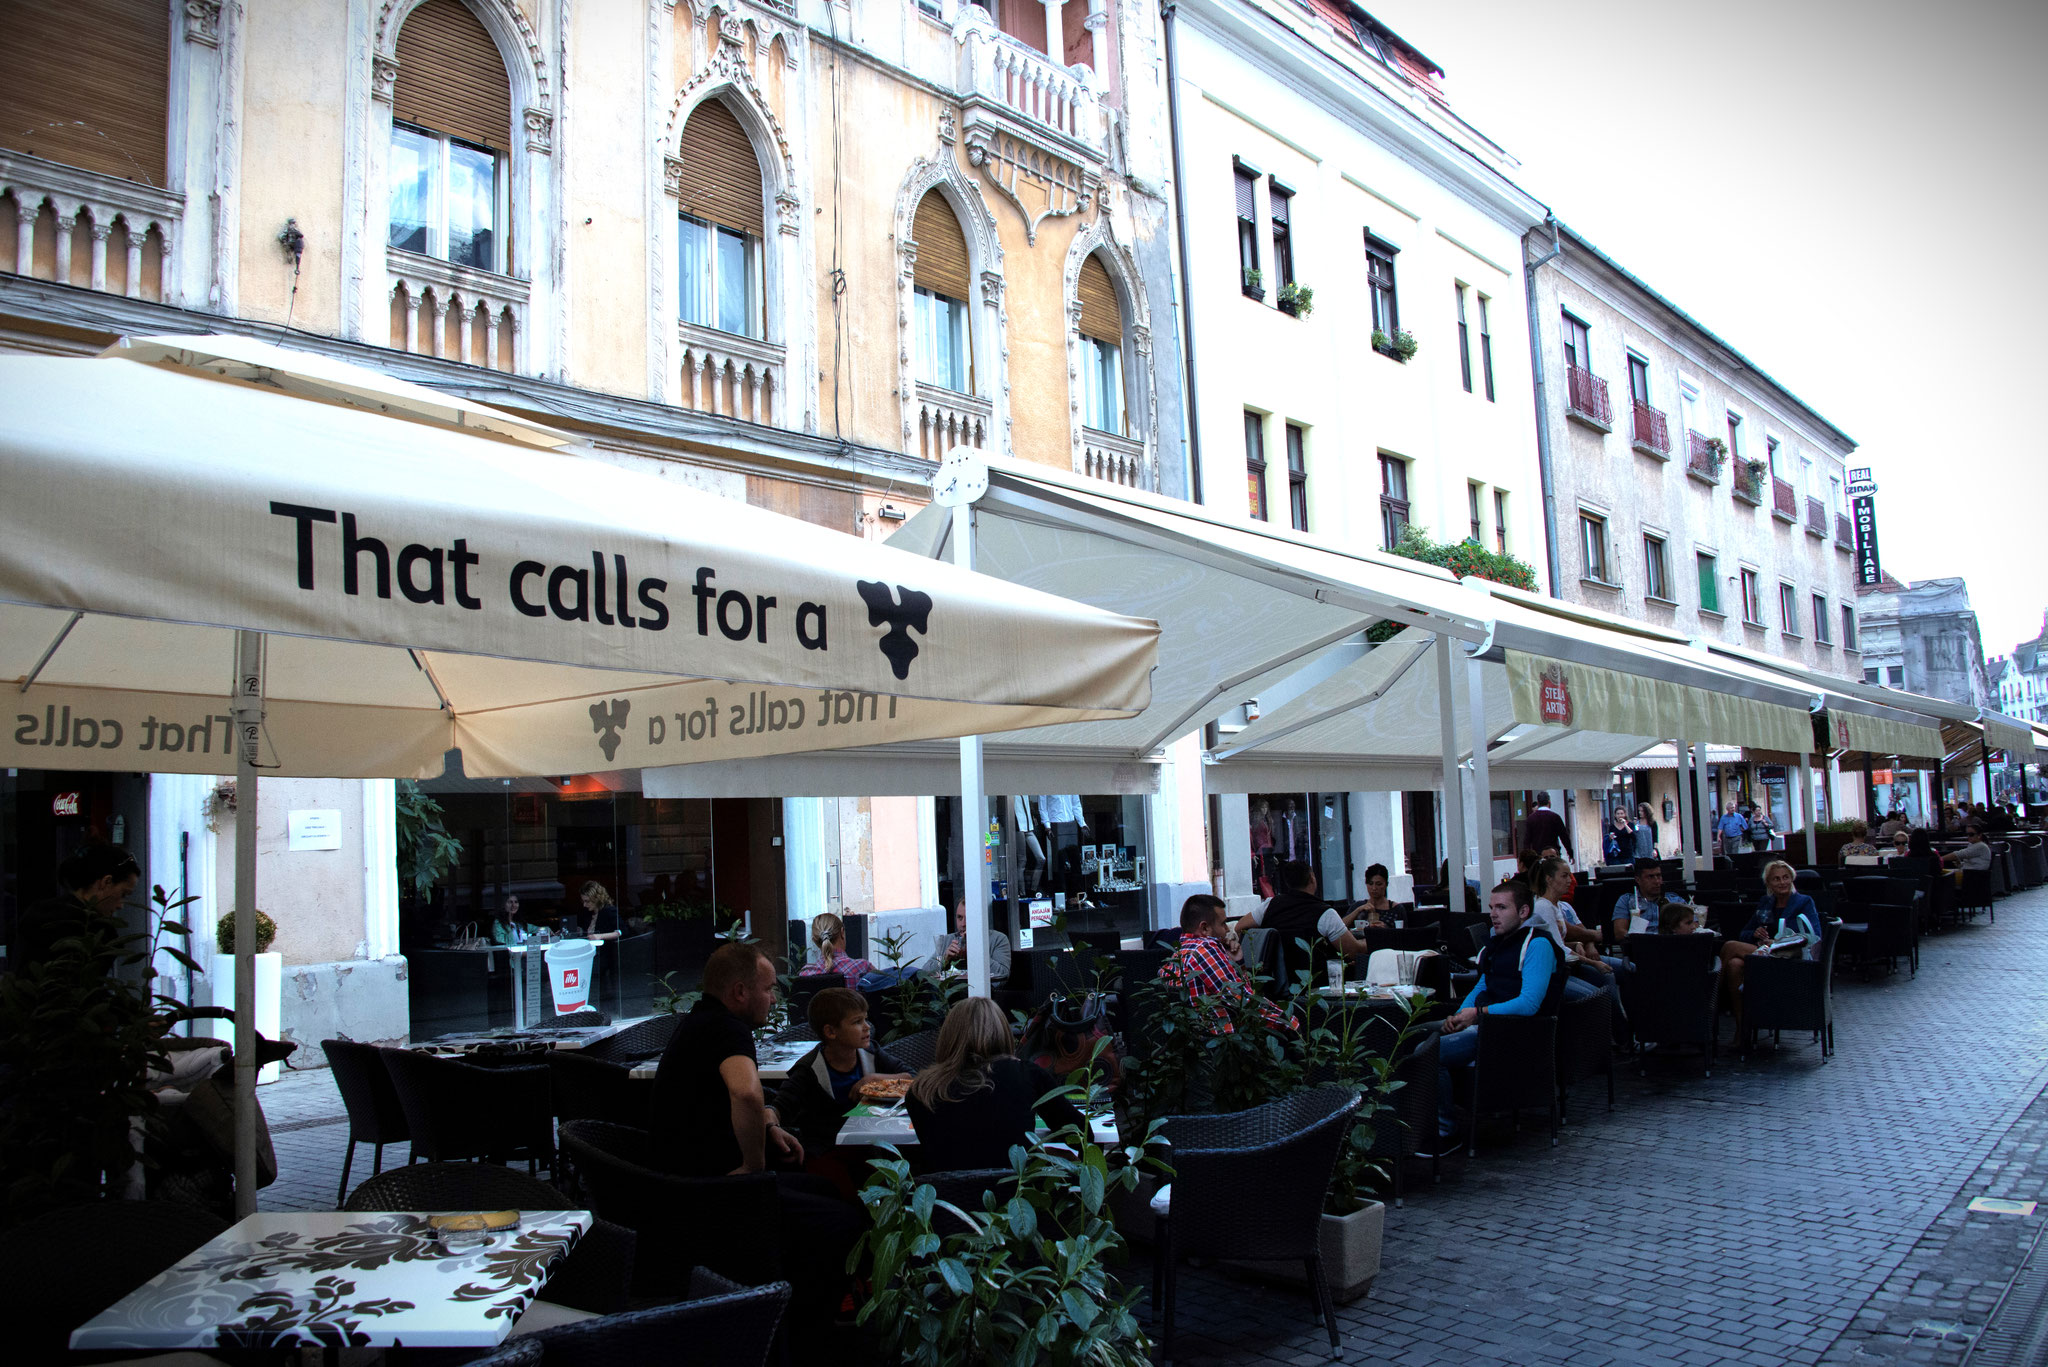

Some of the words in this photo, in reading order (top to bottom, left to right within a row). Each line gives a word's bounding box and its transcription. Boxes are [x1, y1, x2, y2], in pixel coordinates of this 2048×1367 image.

[1851, 468, 1870, 481] REAL
[1857, 499, 1876, 583] IMOBILIARE
[269, 500, 482, 611] That
[509, 550, 670, 632] calls
[692, 566, 777, 644] for
[796, 601, 828, 652] a
[1545, 687, 1566, 701] STELA
[1545, 701, 1567, 715] ARTS
[564, 973, 577, 986] illy
